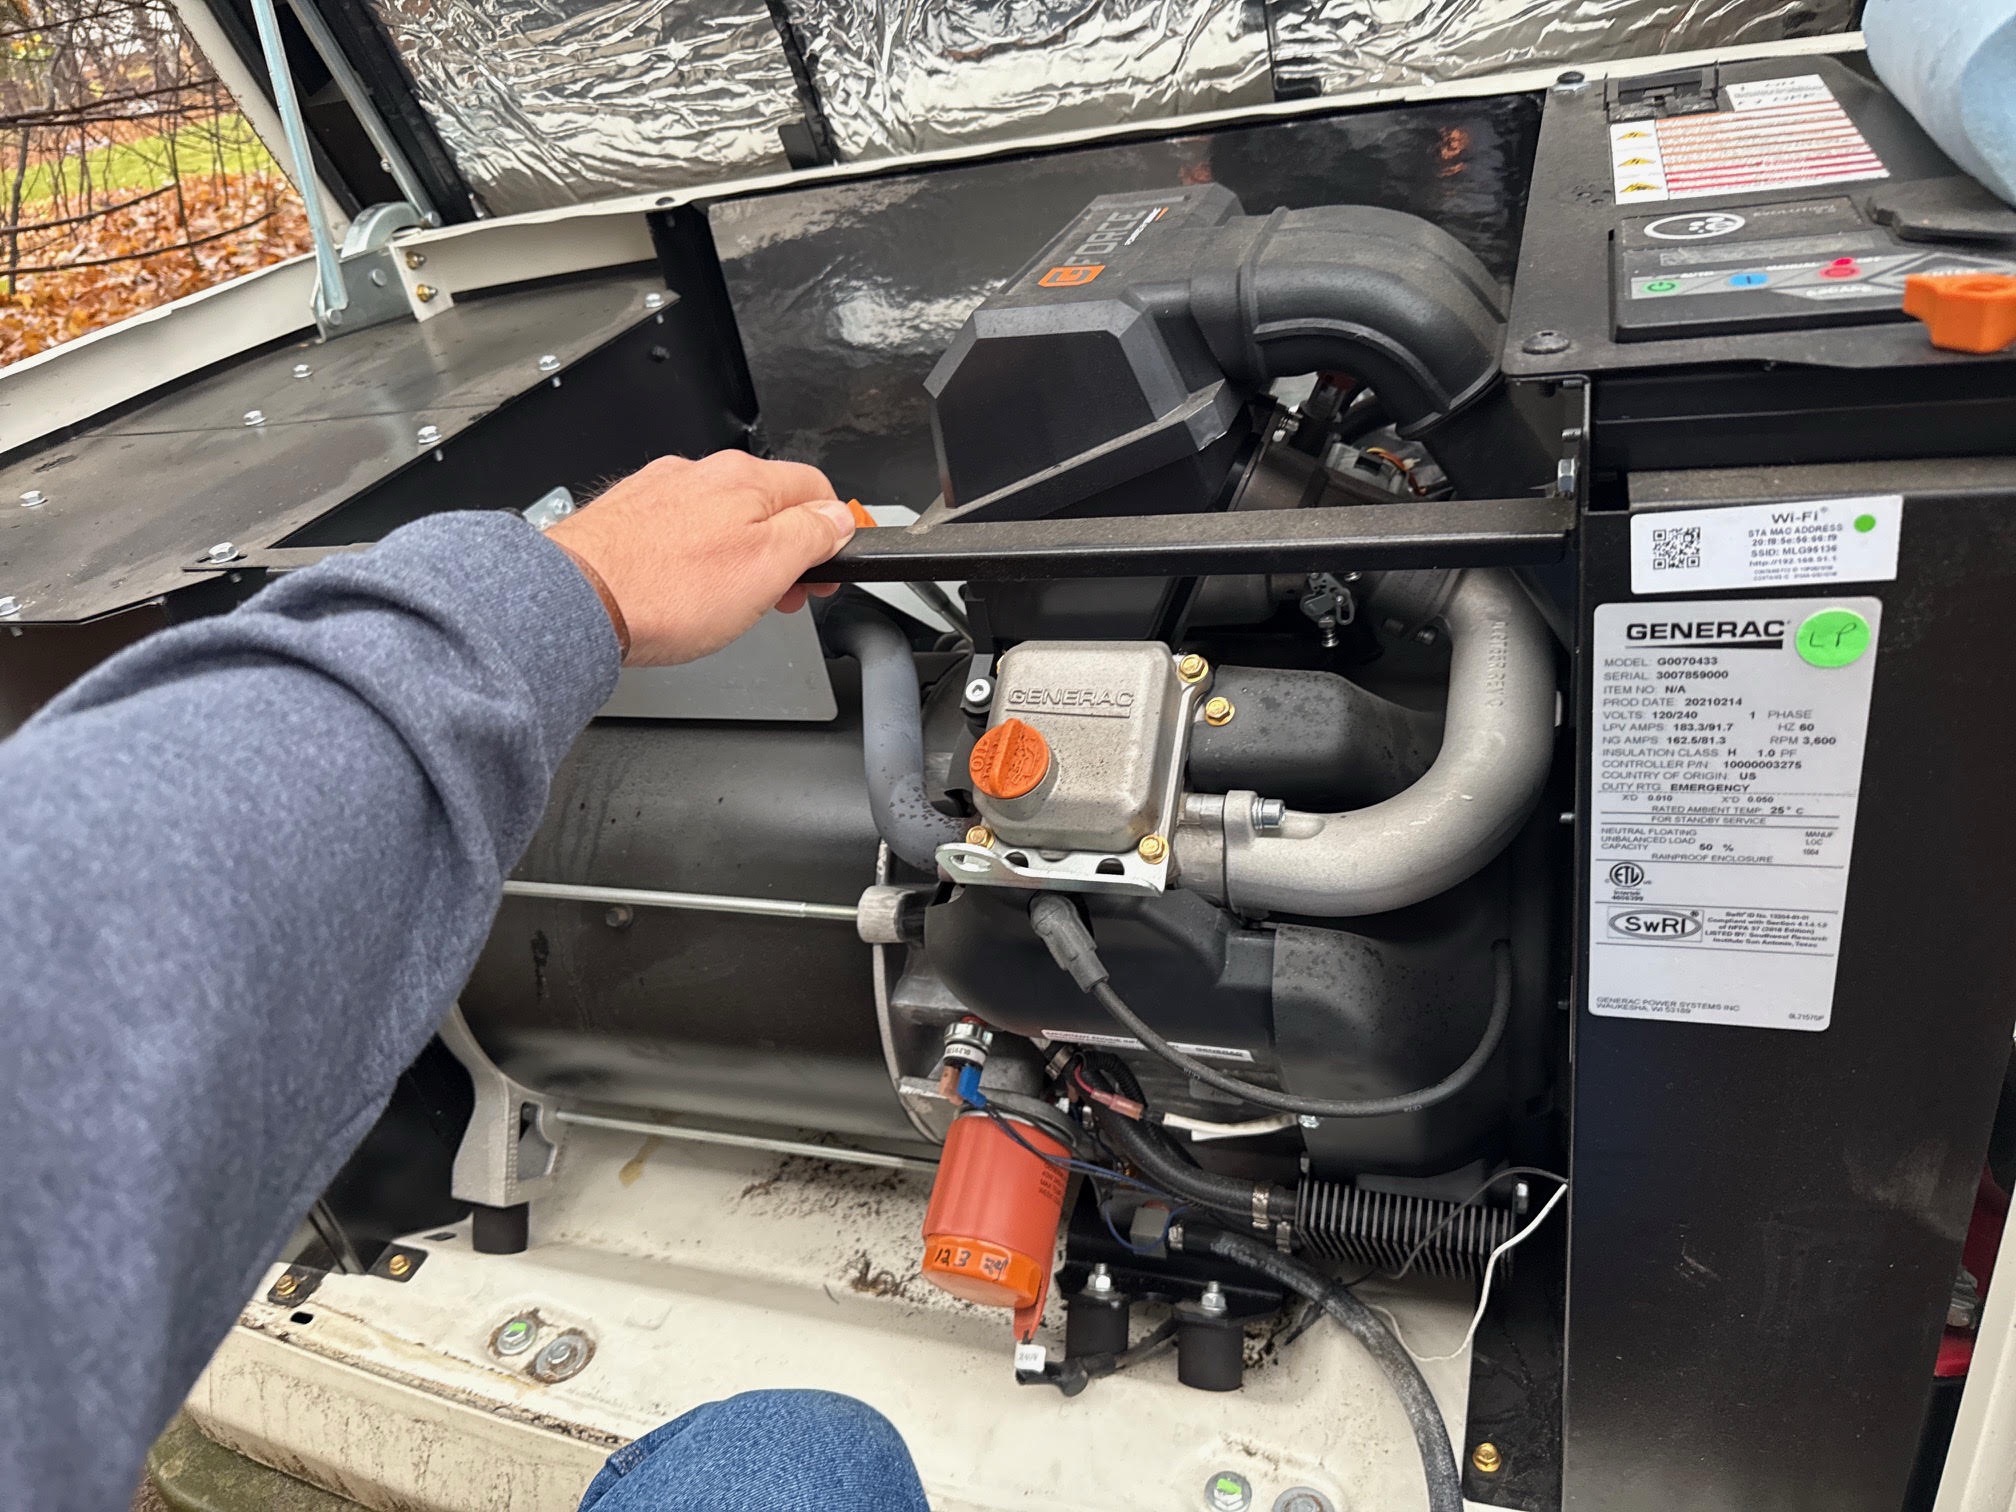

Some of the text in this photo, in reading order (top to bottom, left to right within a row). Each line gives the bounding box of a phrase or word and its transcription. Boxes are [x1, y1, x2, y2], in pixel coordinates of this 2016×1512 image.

[1771, 510, 1818, 524] Wi-Fi
[1794, 523, 1843, 534] ADDRESS
[1626, 620, 1785, 641] GENERAC
[1657, 656, 1718, 666] G0070433
[1603, 685, 1632, 694] ITEM
[1665, 685, 1687, 694] N/A
[1008, 687, 1135, 708] GENERAC
[1603, 697, 1638, 707] PROD
[1685, 698, 1742, 707] 20210214
[1652, 710, 1698, 720] 120/240
[1767, 709, 1814, 719] PHASE
[1673, 723, 1733, 732] 183.3/91.7
[1778, 722, 1796, 731] HZ
[1799, 723, 1815, 732] 60
[1602, 735, 1621, 745] NG
[1770, 735, 1799, 745] RPM
[1802, 736, 1837, 746] 3,600
[1602, 748, 1675, 757] INSULATION
[1728, 748, 1737, 757] H
[1758, 749, 1776, 757] 1.0
[1780, 748, 1798, 757] PF
[1602, 760, 1684, 769] CONTROLLER
[1601, 770, 1660, 780] COUNTRY
[1663, 771, 1680, 780] OF
[1739, 772, 1757, 780] US
[1601, 782, 1634, 791] DUTY
[1670, 783, 1750, 792] EMERGENCY
[1651, 805, 1685, 813] RATED
[1687, 806, 1731, 814] AMBIENT
[1674, 816, 1719, 824] STANDBY
[1723, 817, 1767, 825] SERVICE
[1601, 827, 1646, 835] NEUTRAL
[1648, 828, 1697, 836] FLOATING
[1601, 835, 1696, 845] UNBALANCED LOAD
[1601, 843, 1649, 851] CAPACITY
[1651, 853, 1774, 863] RAINPROOF ENCLOSURE
[1624, 916, 1687, 934] SwRI
[1596, 996, 1640, 1005] GENERAC
[1642, 998, 1677, 1007] POWER
[1680, 1001, 1721, 1010] SYSTEMS
[934, 1248, 951, 1266] 12
